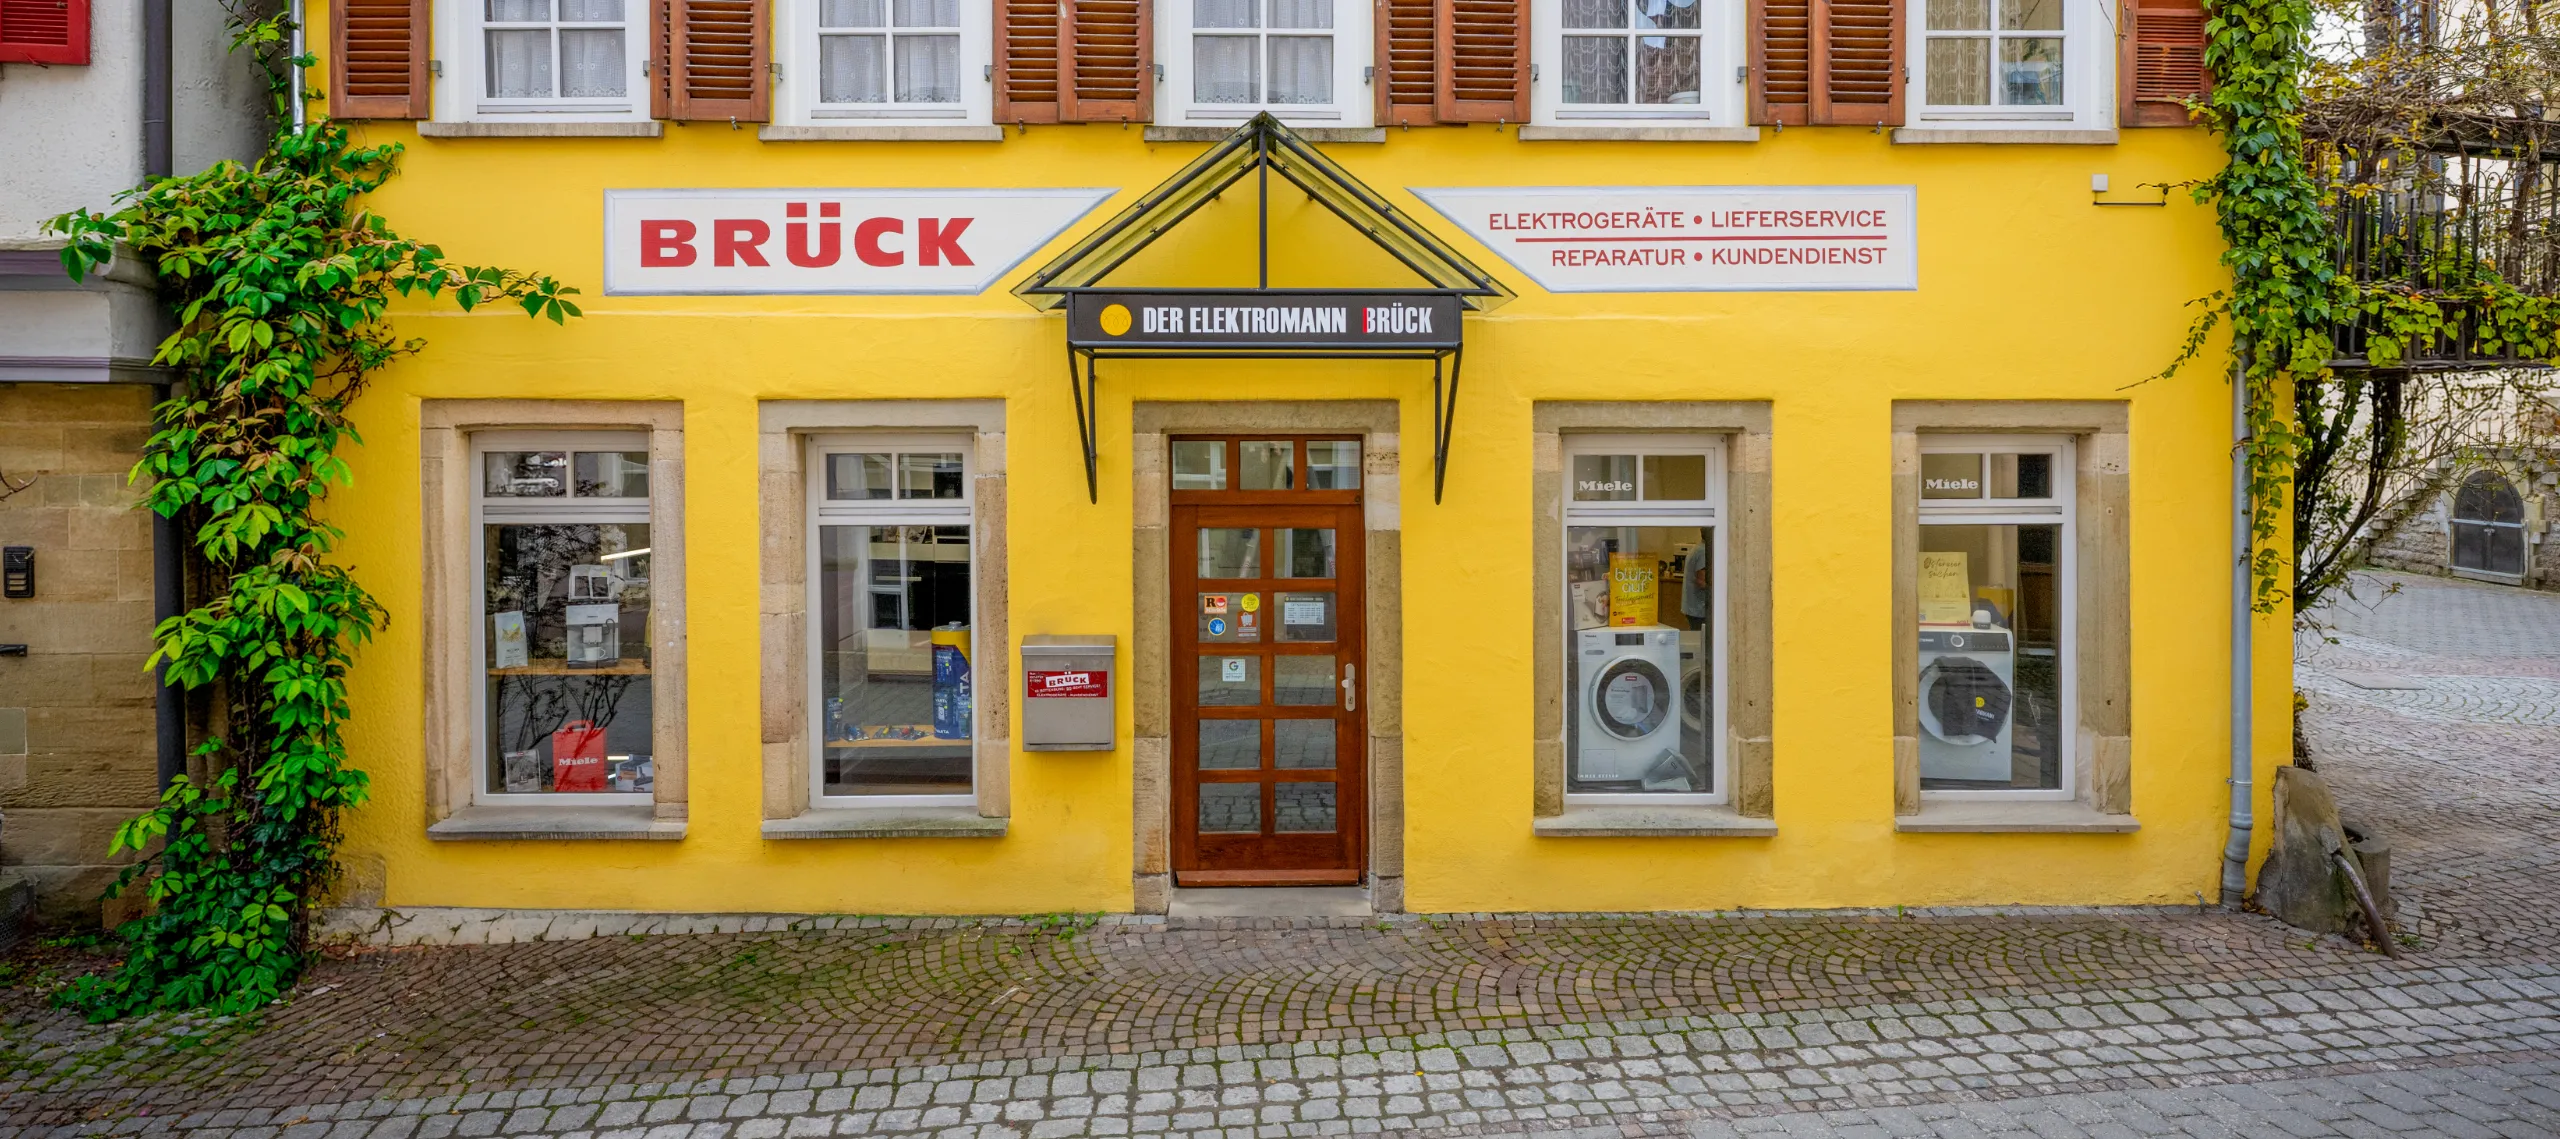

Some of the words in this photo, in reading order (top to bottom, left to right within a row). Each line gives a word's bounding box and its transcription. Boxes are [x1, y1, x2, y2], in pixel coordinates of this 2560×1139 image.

[1489, 207, 1684, 230] ELEKTROGERÄTE
[1711, 210, 1887, 227] LIEFERSERVICE
[640, 202, 975, 268] BRÜCK
[1552, 249, 1685, 266] REPARATUR
[1711, 247, 1887, 265] KUNDENDIENST
[1143, 307, 1184, 333] DER
[1190, 307, 1347, 333] ELEKTROMANN
[1362, 303, 1433, 333] BRÜCK
[1579, 480, 1633, 492] Miele
[1926, 479, 1978, 490] Miele
[1048, 671, 1087, 687] BRÜCK
[558, 757, 599, 767] Miele
